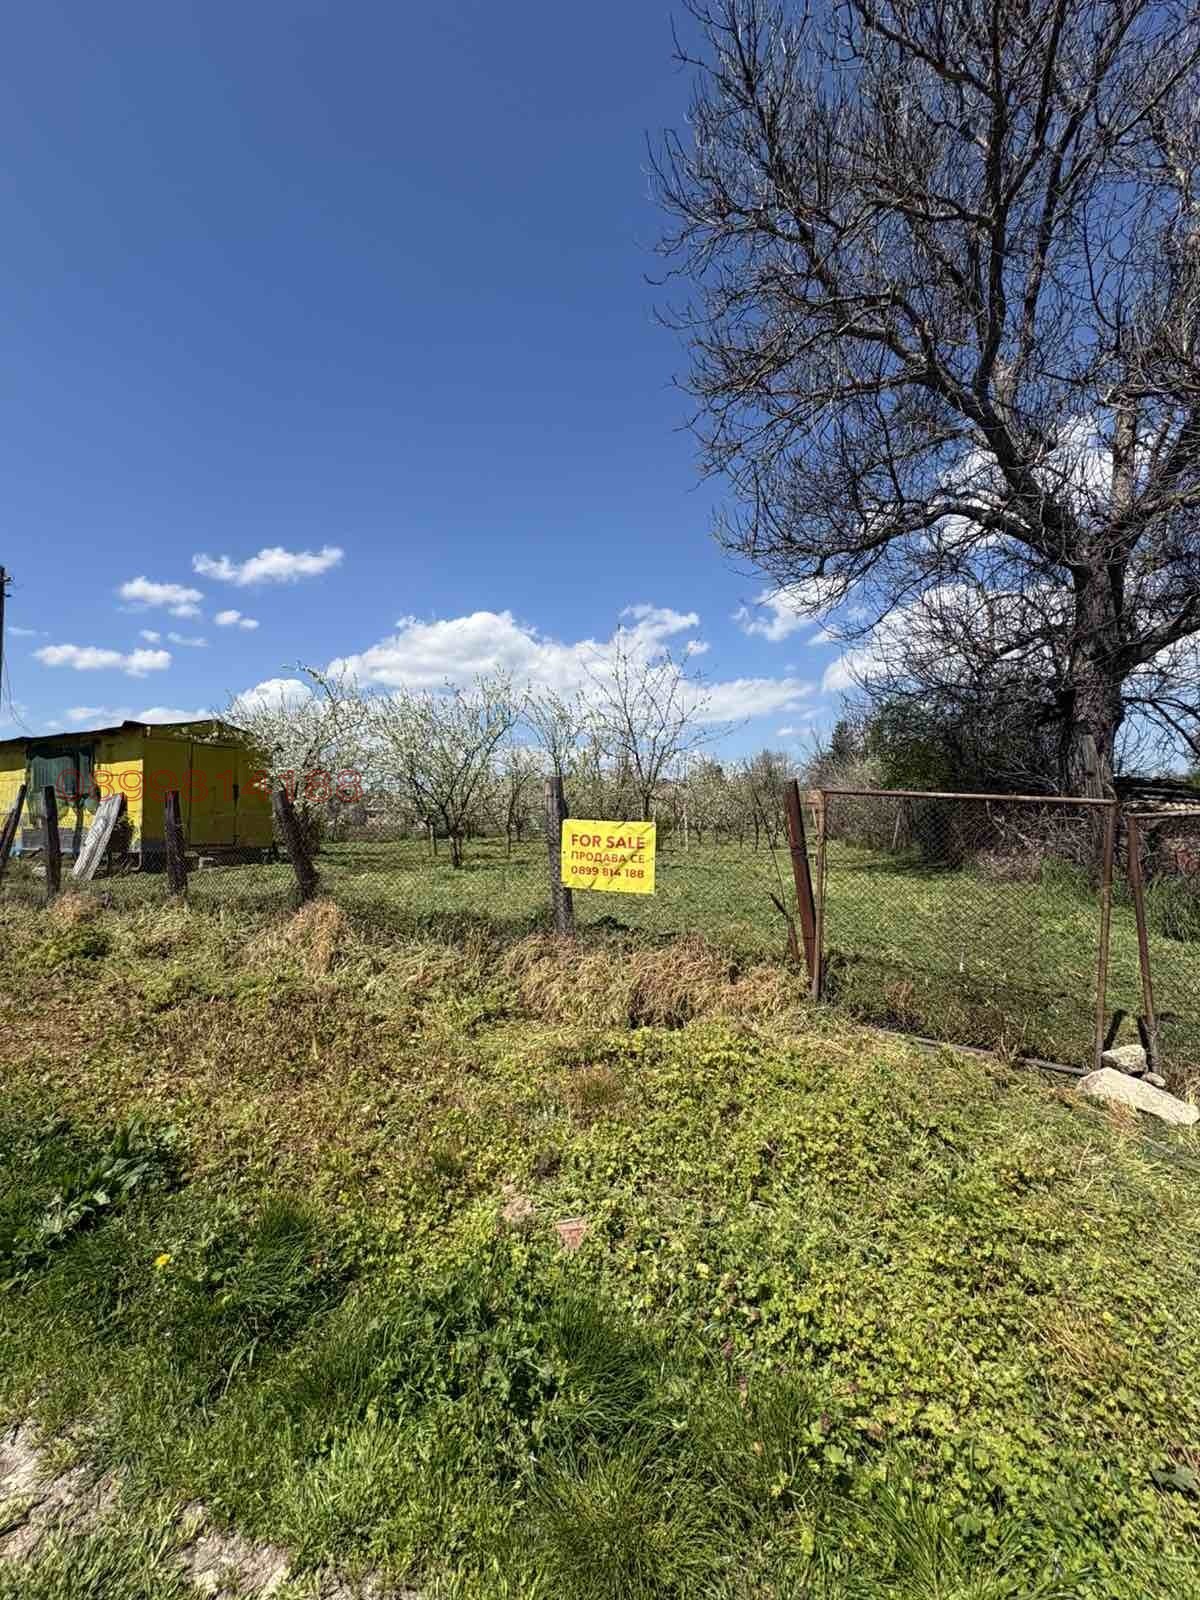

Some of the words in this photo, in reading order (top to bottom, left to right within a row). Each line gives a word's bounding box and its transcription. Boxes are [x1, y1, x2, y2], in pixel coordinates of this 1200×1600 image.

[571, 834, 602, 847] FOR
[606, 836, 646, 849] SALE
[571, 851, 626, 864] ПРОДАВА
[630, 854, 645, 864] СЕ
[571, 865, 599, 876] 0899
[602, 867, 621, 878] 814
[625, 868, 645, 879] 188
